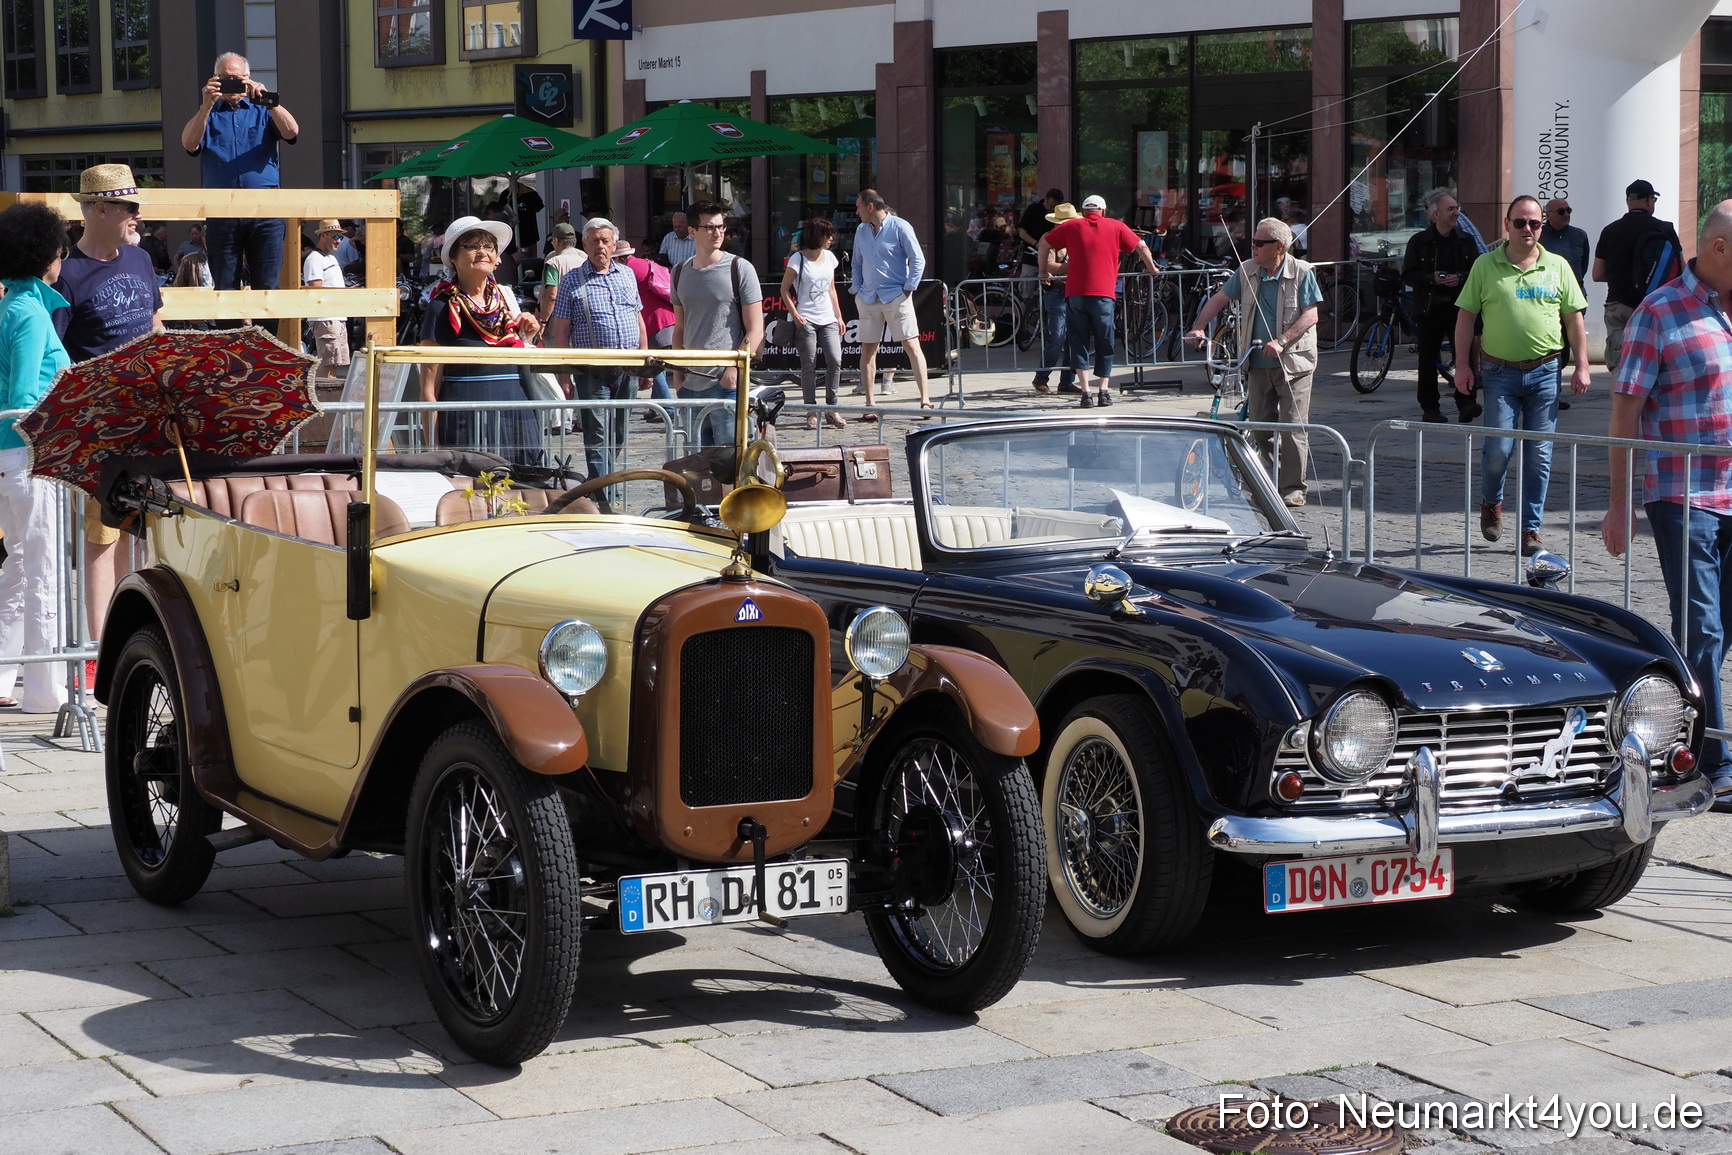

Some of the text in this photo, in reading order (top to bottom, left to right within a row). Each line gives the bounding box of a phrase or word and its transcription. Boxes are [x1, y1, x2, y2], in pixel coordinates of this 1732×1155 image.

[638, 56, 681, 70] Unterer Markt 15
[710, 144, 794, 155] Lammsbräu
[1554, 99, 1570, 200] COMMUNITY.
[1538, 128, 1552, 200] PASSION.
[92, 279, 151, 307] URBAN LIFE
[113, 290, 140, 309] Style
[738, 604, 759, 621] DIXI
[1421, 671, 1587, 692] TRIUMPH
[828, 868, 843, 880] 05
[1289, 854, 1446, 904] DON 0754
[645, 881, 694, 923] RH
[778, 870, 820, 910] 81
[829, 895, 843, 907] 10
[1272, 893, 1281, 904] D
[629, 910, 637, 922] D
